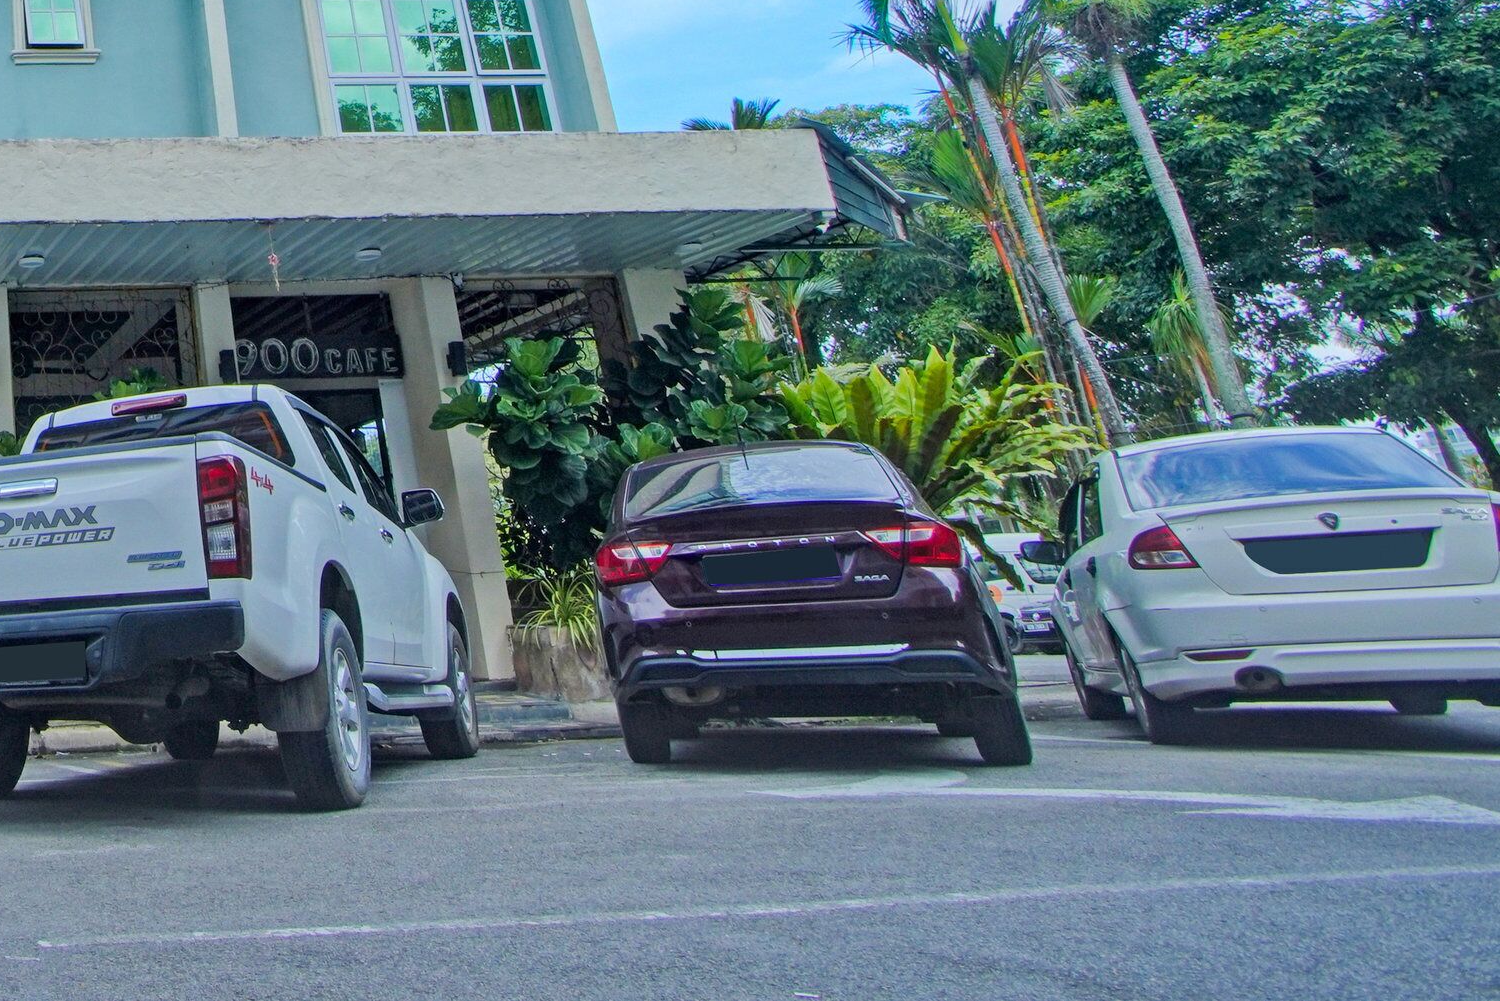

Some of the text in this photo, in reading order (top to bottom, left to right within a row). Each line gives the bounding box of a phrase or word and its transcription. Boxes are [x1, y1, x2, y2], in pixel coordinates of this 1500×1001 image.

[235, 337, 398, 376] 900 CAFE
[698, 535, 836, 550] PROTON
[854, 574, 890, 582] SAGA
